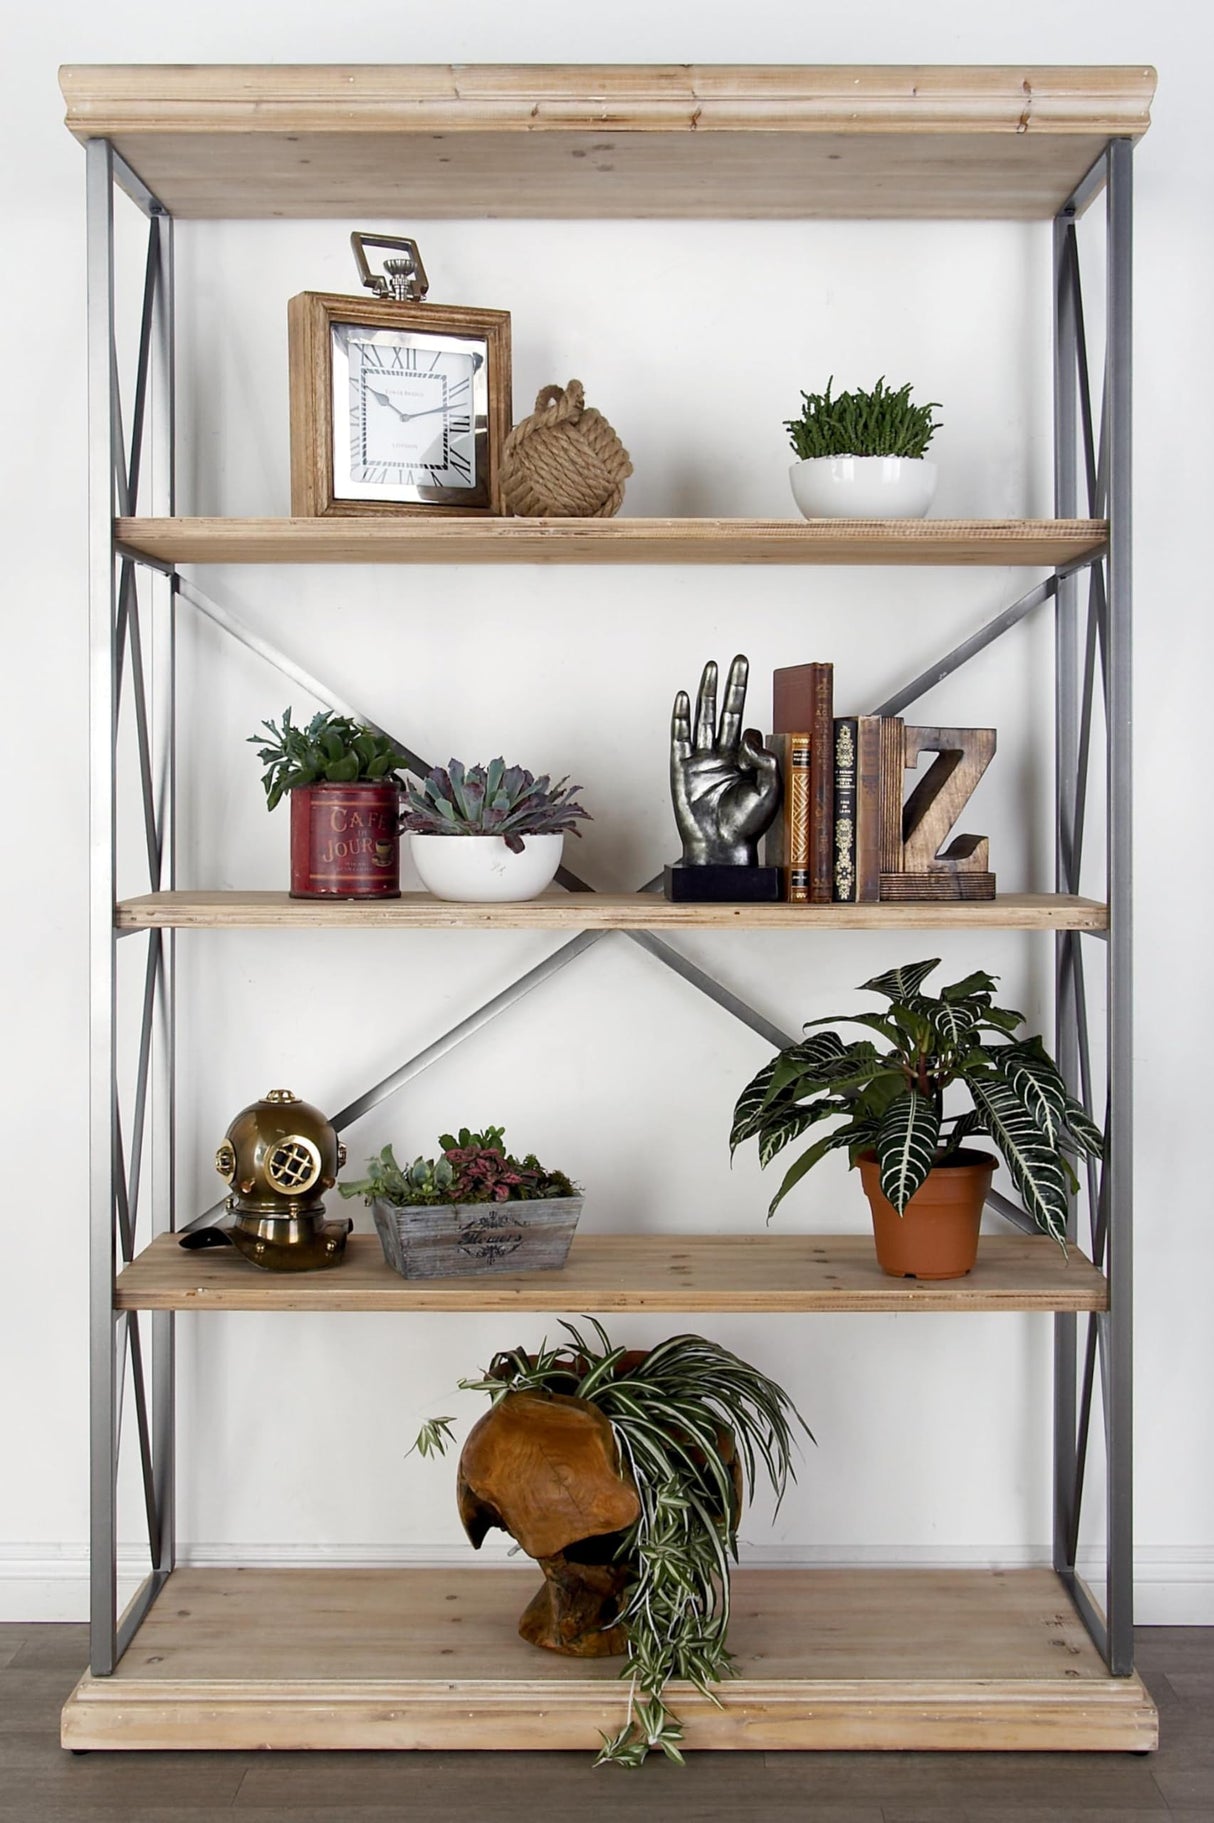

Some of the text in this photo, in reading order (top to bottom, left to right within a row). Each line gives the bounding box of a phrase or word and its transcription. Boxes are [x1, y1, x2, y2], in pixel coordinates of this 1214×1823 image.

[391, 347, 417, 370] XII
[448, 414, 471, 433] III
[904, 726, 997, 873] Z
[322, 837, 374, 863] JOUR
